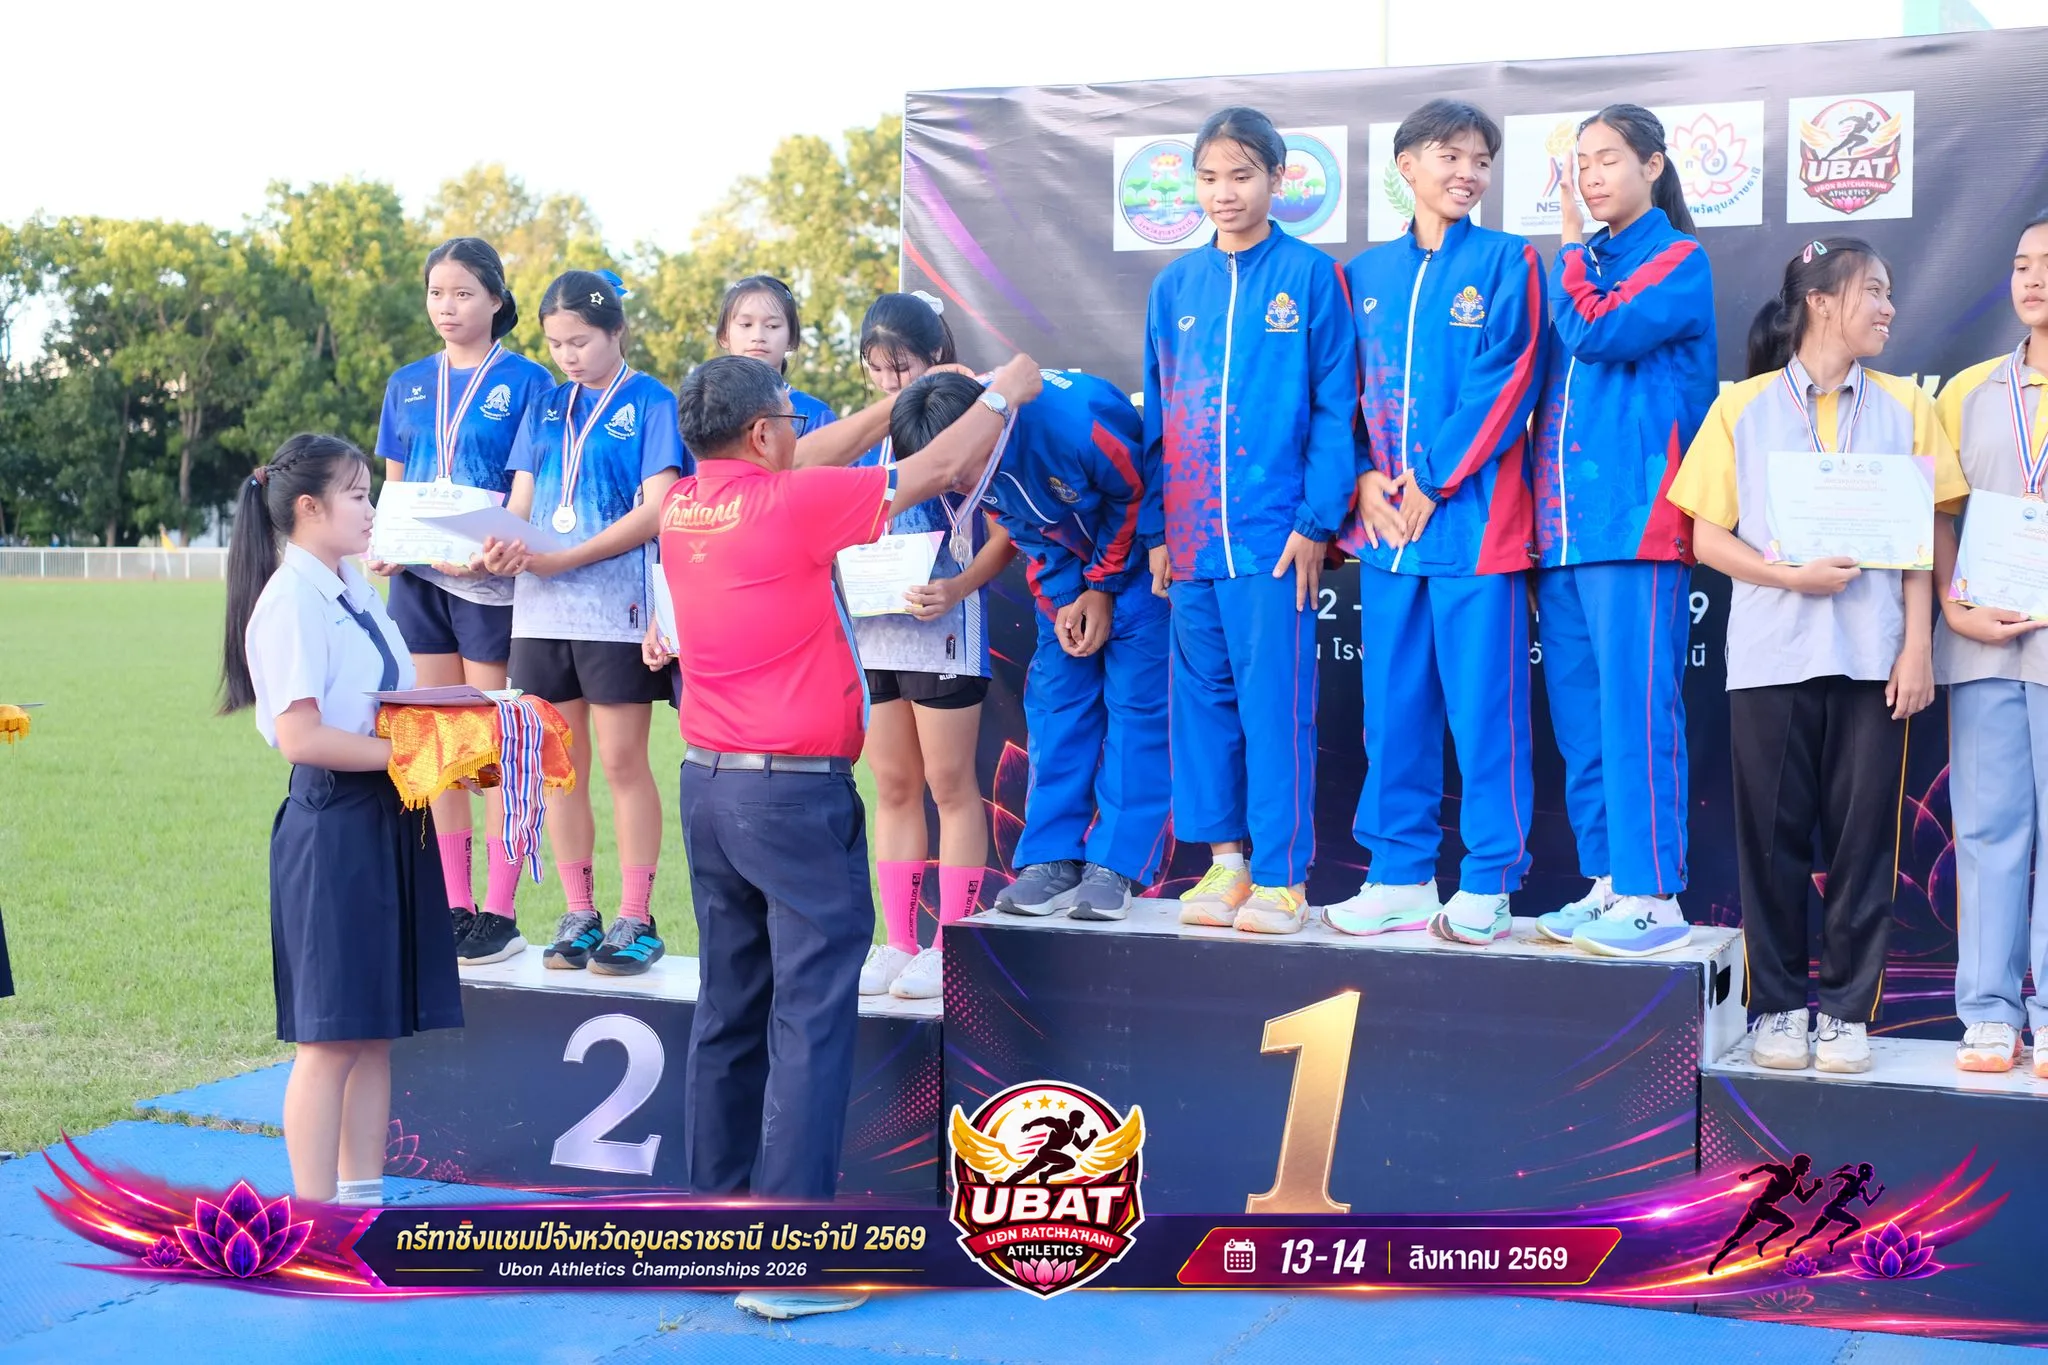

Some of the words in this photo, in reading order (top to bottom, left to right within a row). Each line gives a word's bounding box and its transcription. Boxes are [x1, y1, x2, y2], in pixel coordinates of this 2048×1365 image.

[1807, 157, 1893, 182] UBAT
[1828, 189, 1871, 197] ATHLETICS
[662, 493, 743, 534] Thailand
[550, 1013, 665, 1176] 2
[1245, 990, 1361, 1214] 1
